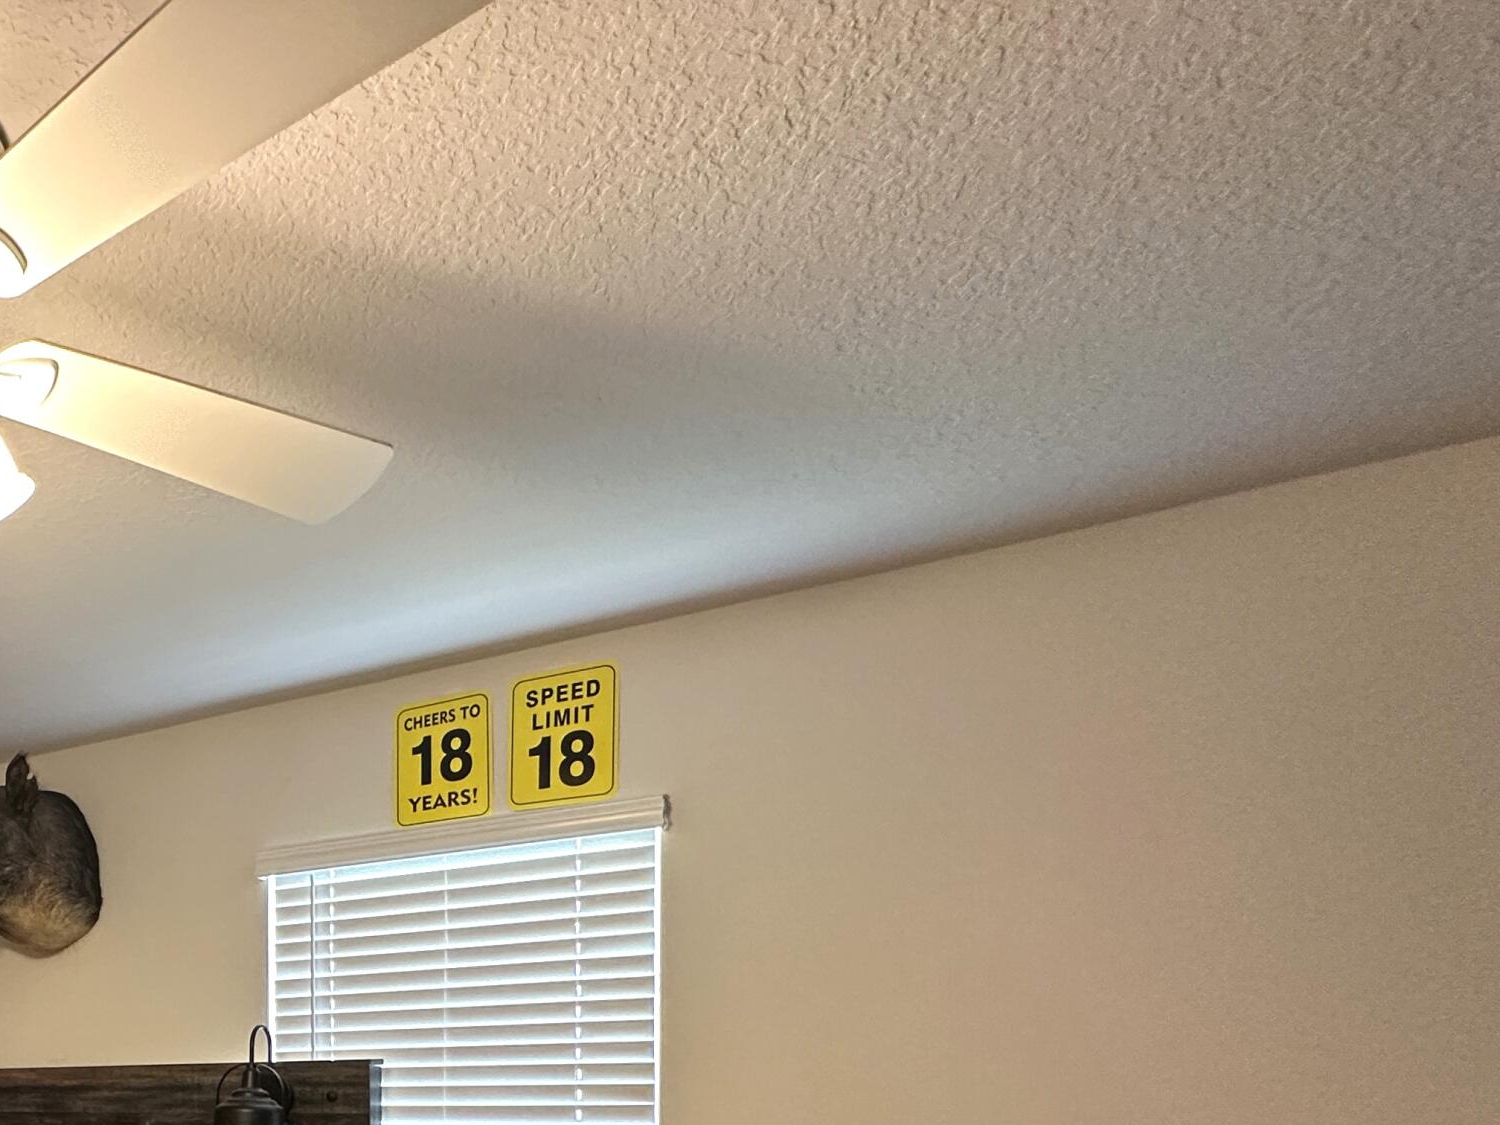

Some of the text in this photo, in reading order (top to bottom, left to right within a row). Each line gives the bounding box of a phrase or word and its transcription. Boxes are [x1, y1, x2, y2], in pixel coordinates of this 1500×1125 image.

[526, 679, 601, 708] SPEED
[404, 703, 481, 732] CHEERS TO
[531, 704, 595, 731] LIMIT
[411, 728, 473, 786] 18
[528, 729, 596, 790] 18
[408, 788, 478, 813] YEARS!
